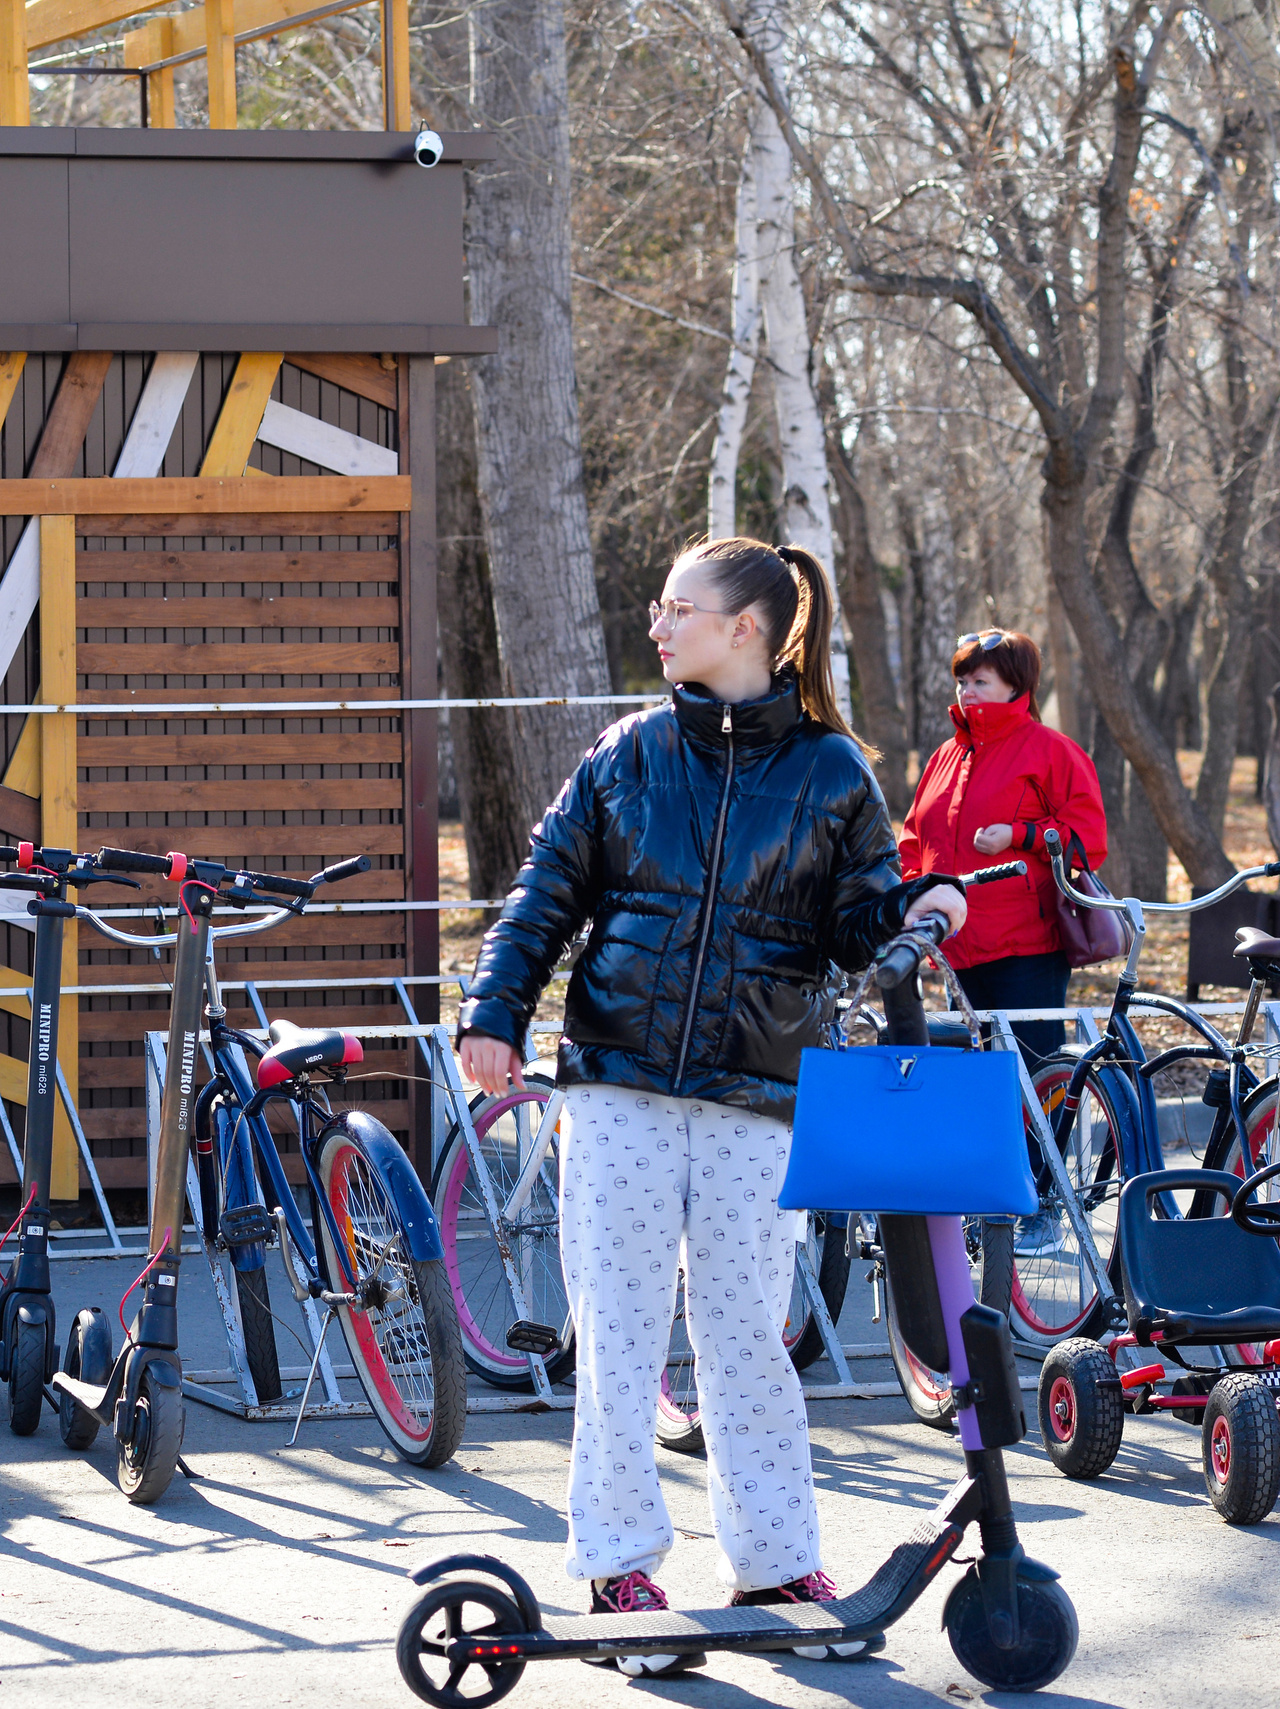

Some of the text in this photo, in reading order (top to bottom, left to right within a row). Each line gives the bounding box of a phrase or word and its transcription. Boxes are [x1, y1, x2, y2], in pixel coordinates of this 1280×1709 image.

[37, 1003, 52, 1095] MINIPRO mi626
[178, 1030, 195, 1131] MINIPRO mi626
[305, 1053, 323, 1064] HERO
